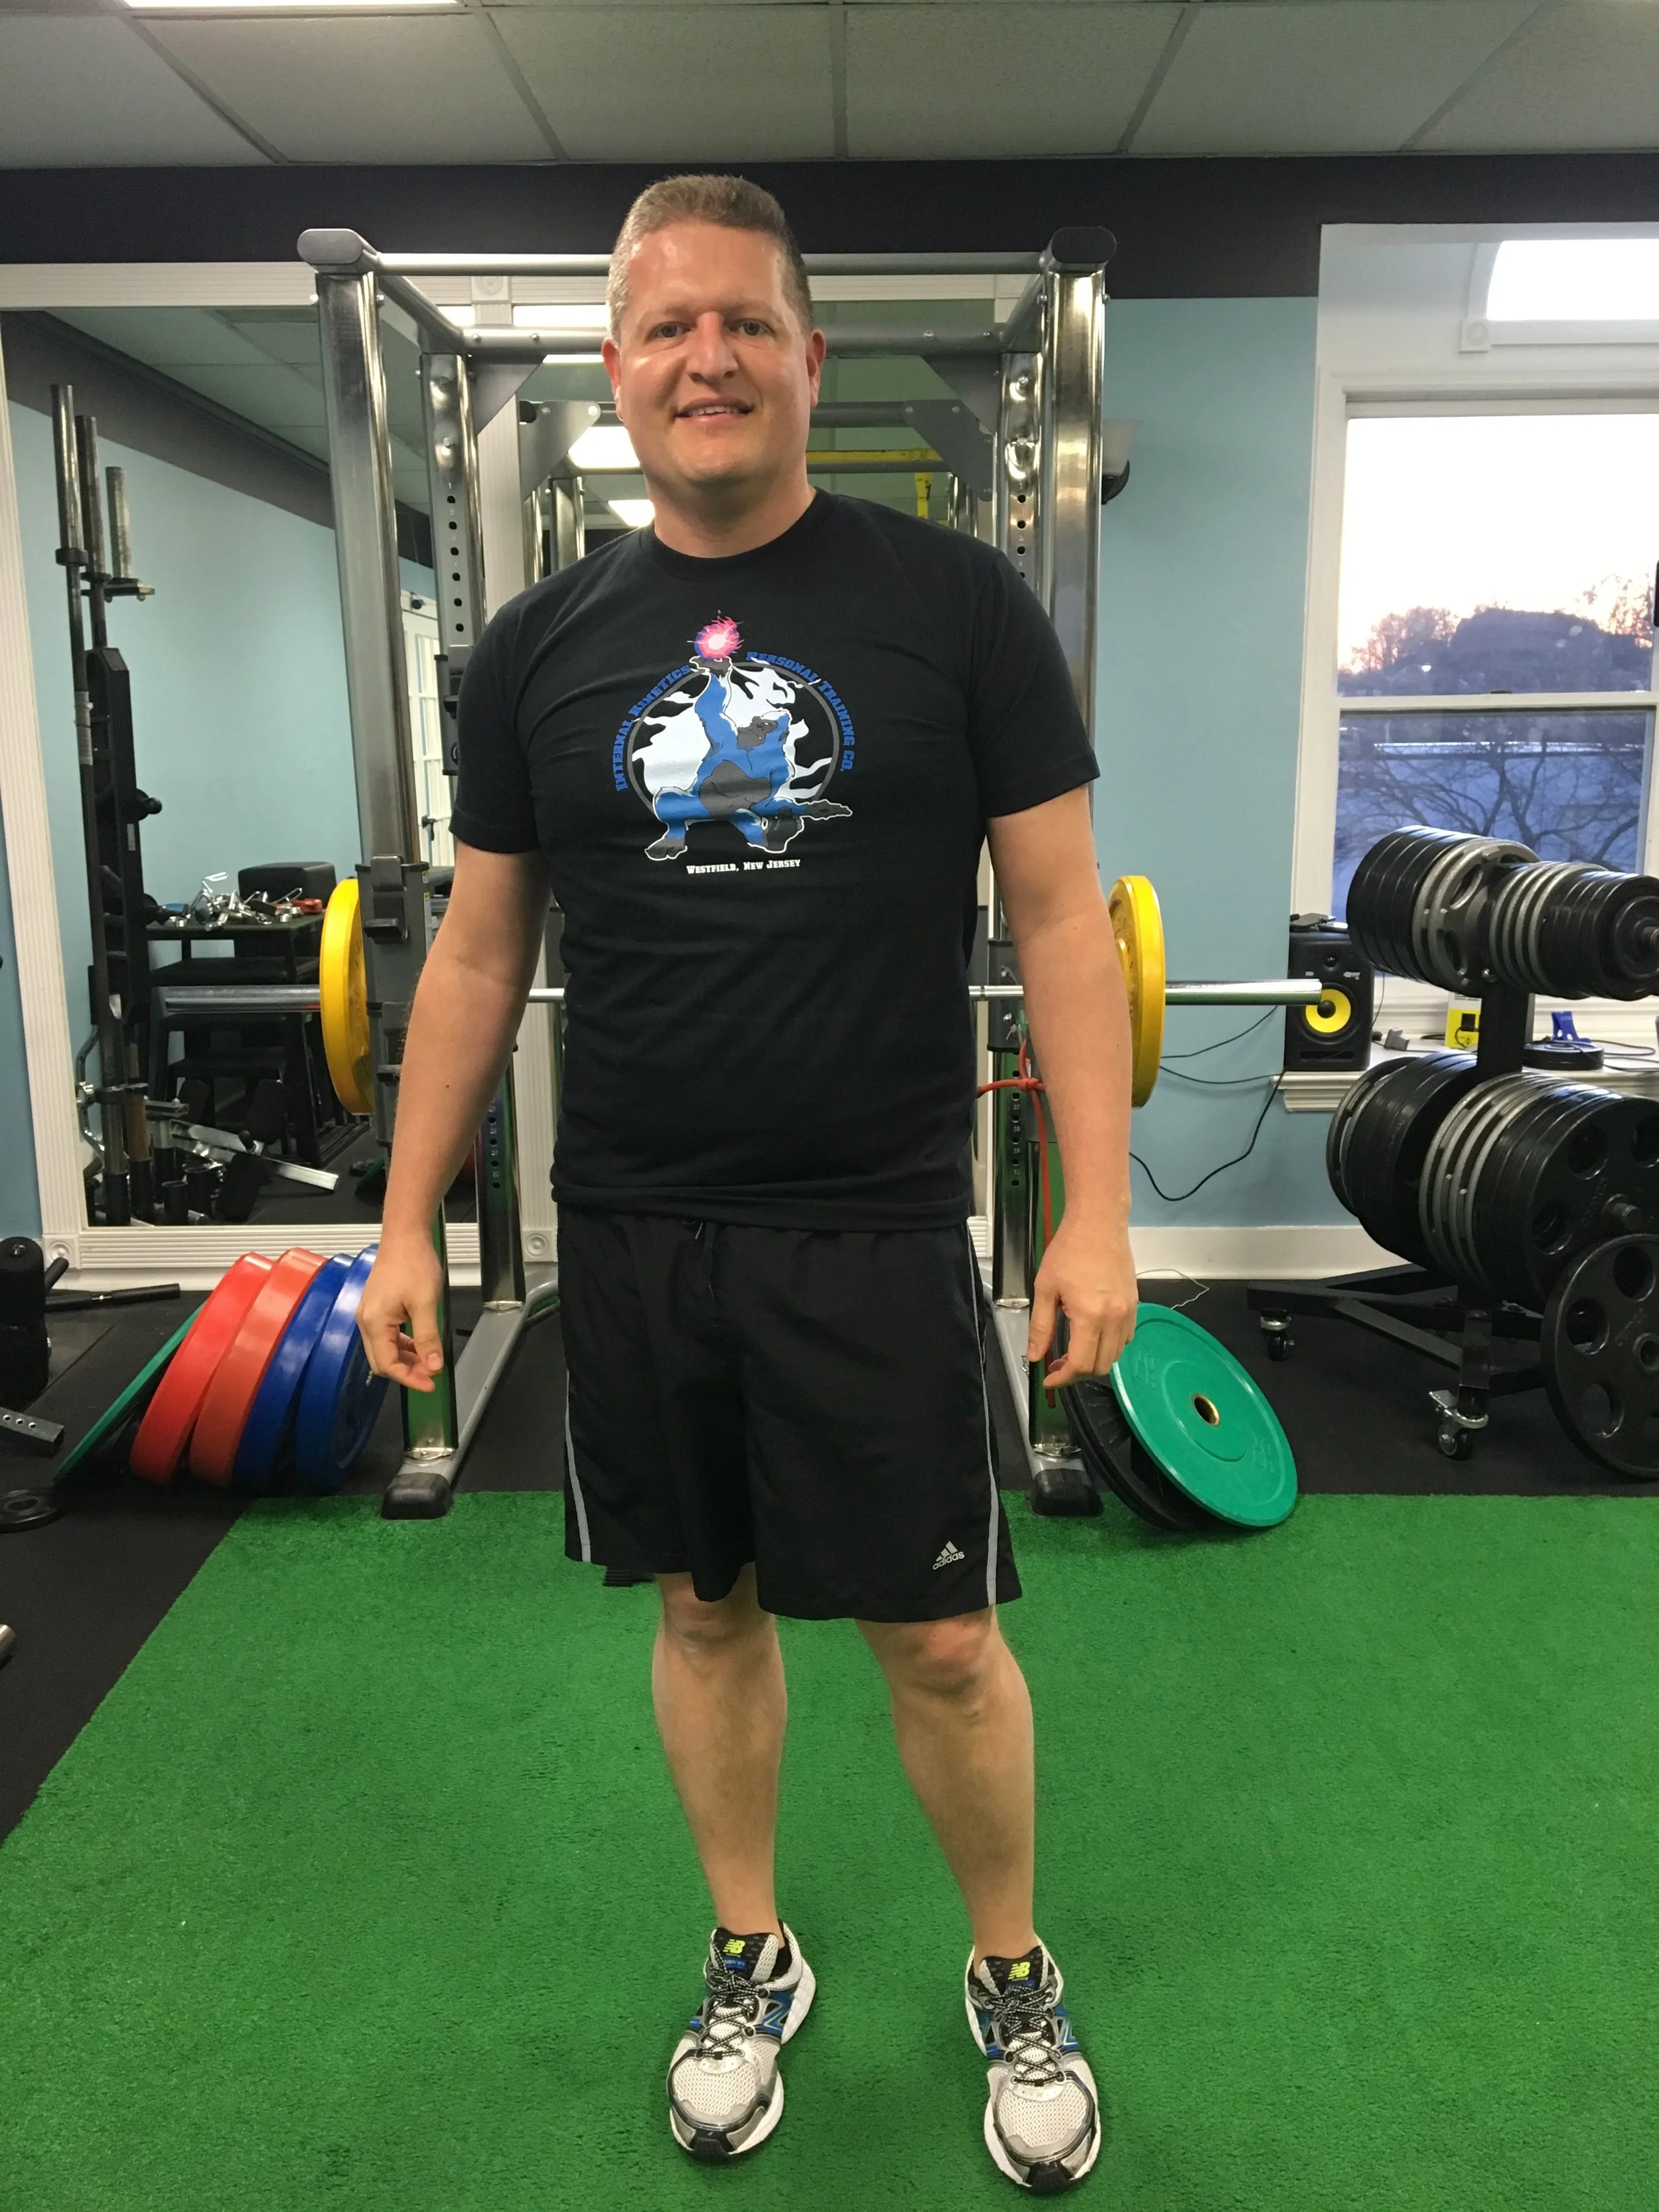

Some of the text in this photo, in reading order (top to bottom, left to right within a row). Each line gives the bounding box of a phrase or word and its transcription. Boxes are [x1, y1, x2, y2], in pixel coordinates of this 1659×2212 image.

[745, 651, 820, 684] PERSONAL
[818, 680, 855, 746] TRAINING
[612, 664, 691, 792] INTERNAL KINETICS
[685, 859, 801, 875] WESTFIELD, NEW JERSEY
[932, 1550, 966, 1571] adidas
